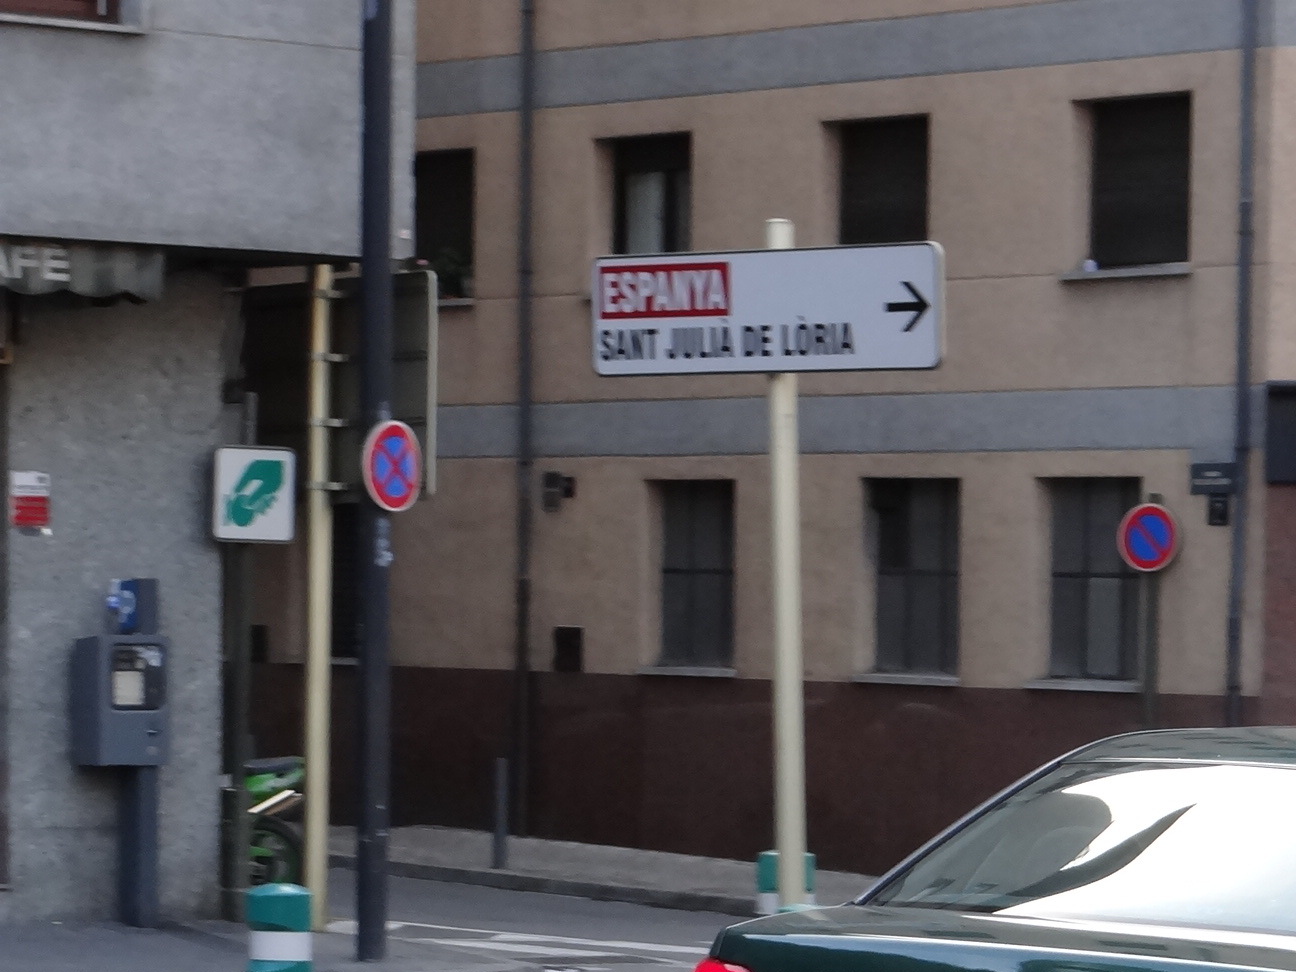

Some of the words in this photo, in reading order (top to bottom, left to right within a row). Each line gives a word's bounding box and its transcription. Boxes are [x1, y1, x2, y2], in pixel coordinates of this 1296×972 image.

[602, 269, 726, 314] ESPANYA
[601, 328, 659, 361] SANT
[741, 323, 773, 357] DE
[781, 315, 855, 357] LÒRIA
